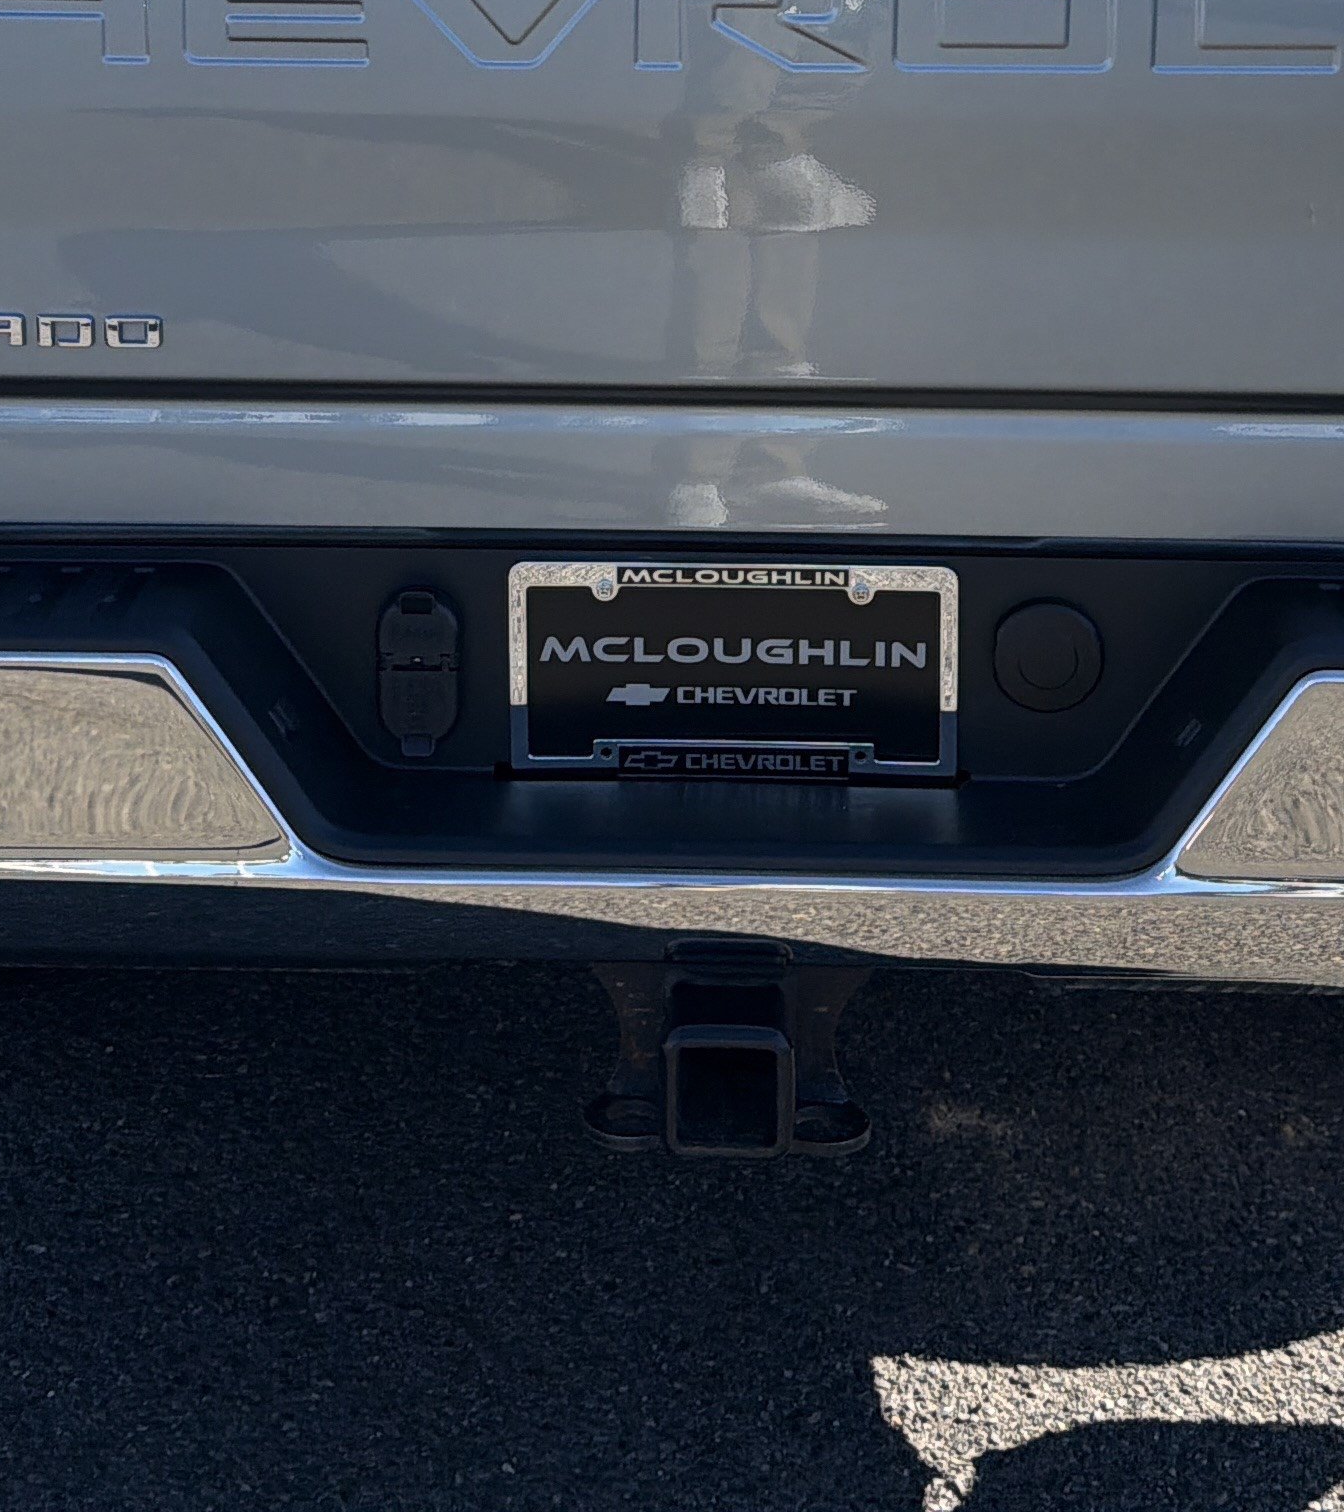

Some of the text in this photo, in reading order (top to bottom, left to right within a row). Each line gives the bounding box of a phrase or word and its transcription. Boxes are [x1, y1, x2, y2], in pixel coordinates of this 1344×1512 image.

[621, 567, 846, 587] MCLOUGHLIN
[539, 635, 927, 670] MCLOUGHLIN
[676, 686, 857, 708] CHEVROLET
[685, 753, 845, 773] CHEVROLET
